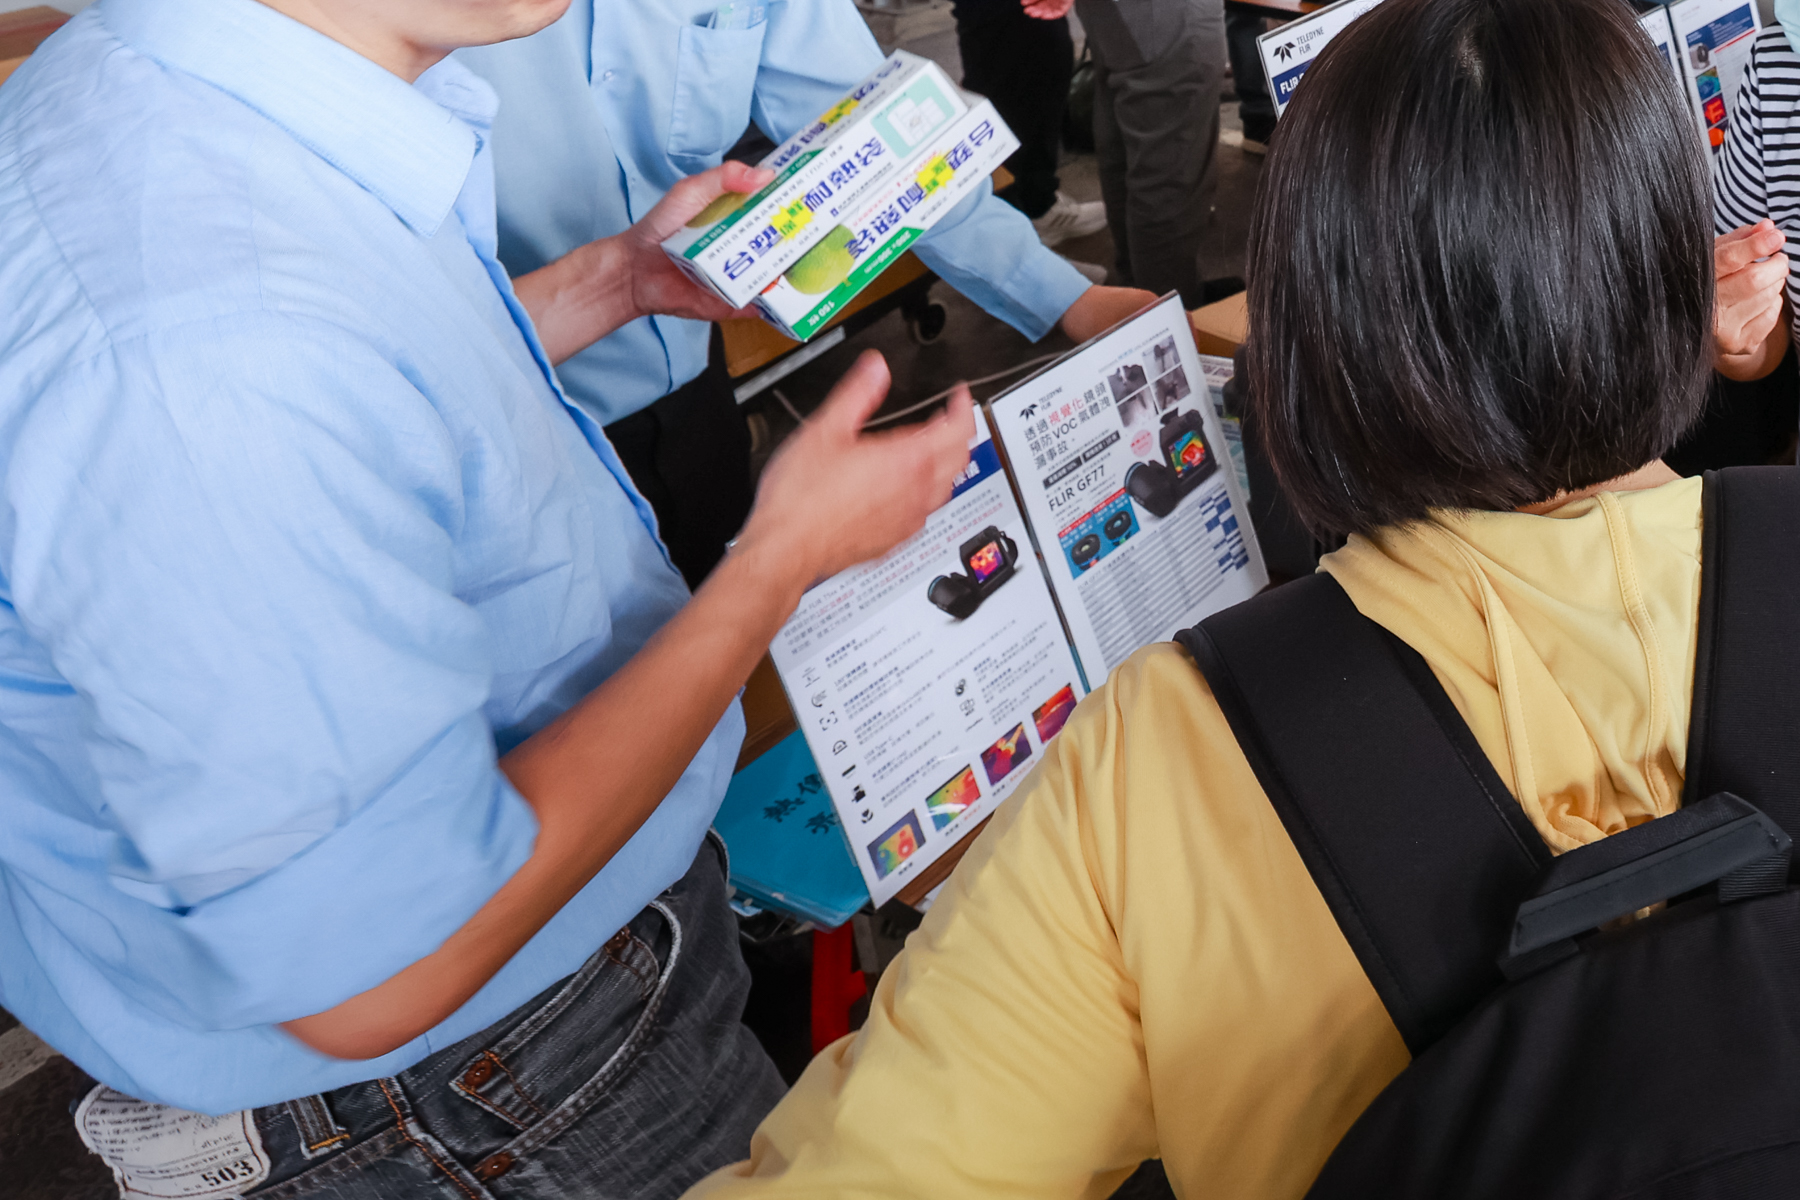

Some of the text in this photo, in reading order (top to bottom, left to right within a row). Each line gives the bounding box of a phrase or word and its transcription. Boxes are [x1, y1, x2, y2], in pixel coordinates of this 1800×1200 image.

[1296, 26, 1324, 45] TELEDYNE
[1299, 43, 1312, 55] FLIR
[1280, 76, 1299, 95] FLIR
[1024, 382, 1107, 440] 透過視覺化鏡頭
[1048, 464, 1106, 511] FLIR GF77
[202, 1160, 254, 1186] 503
